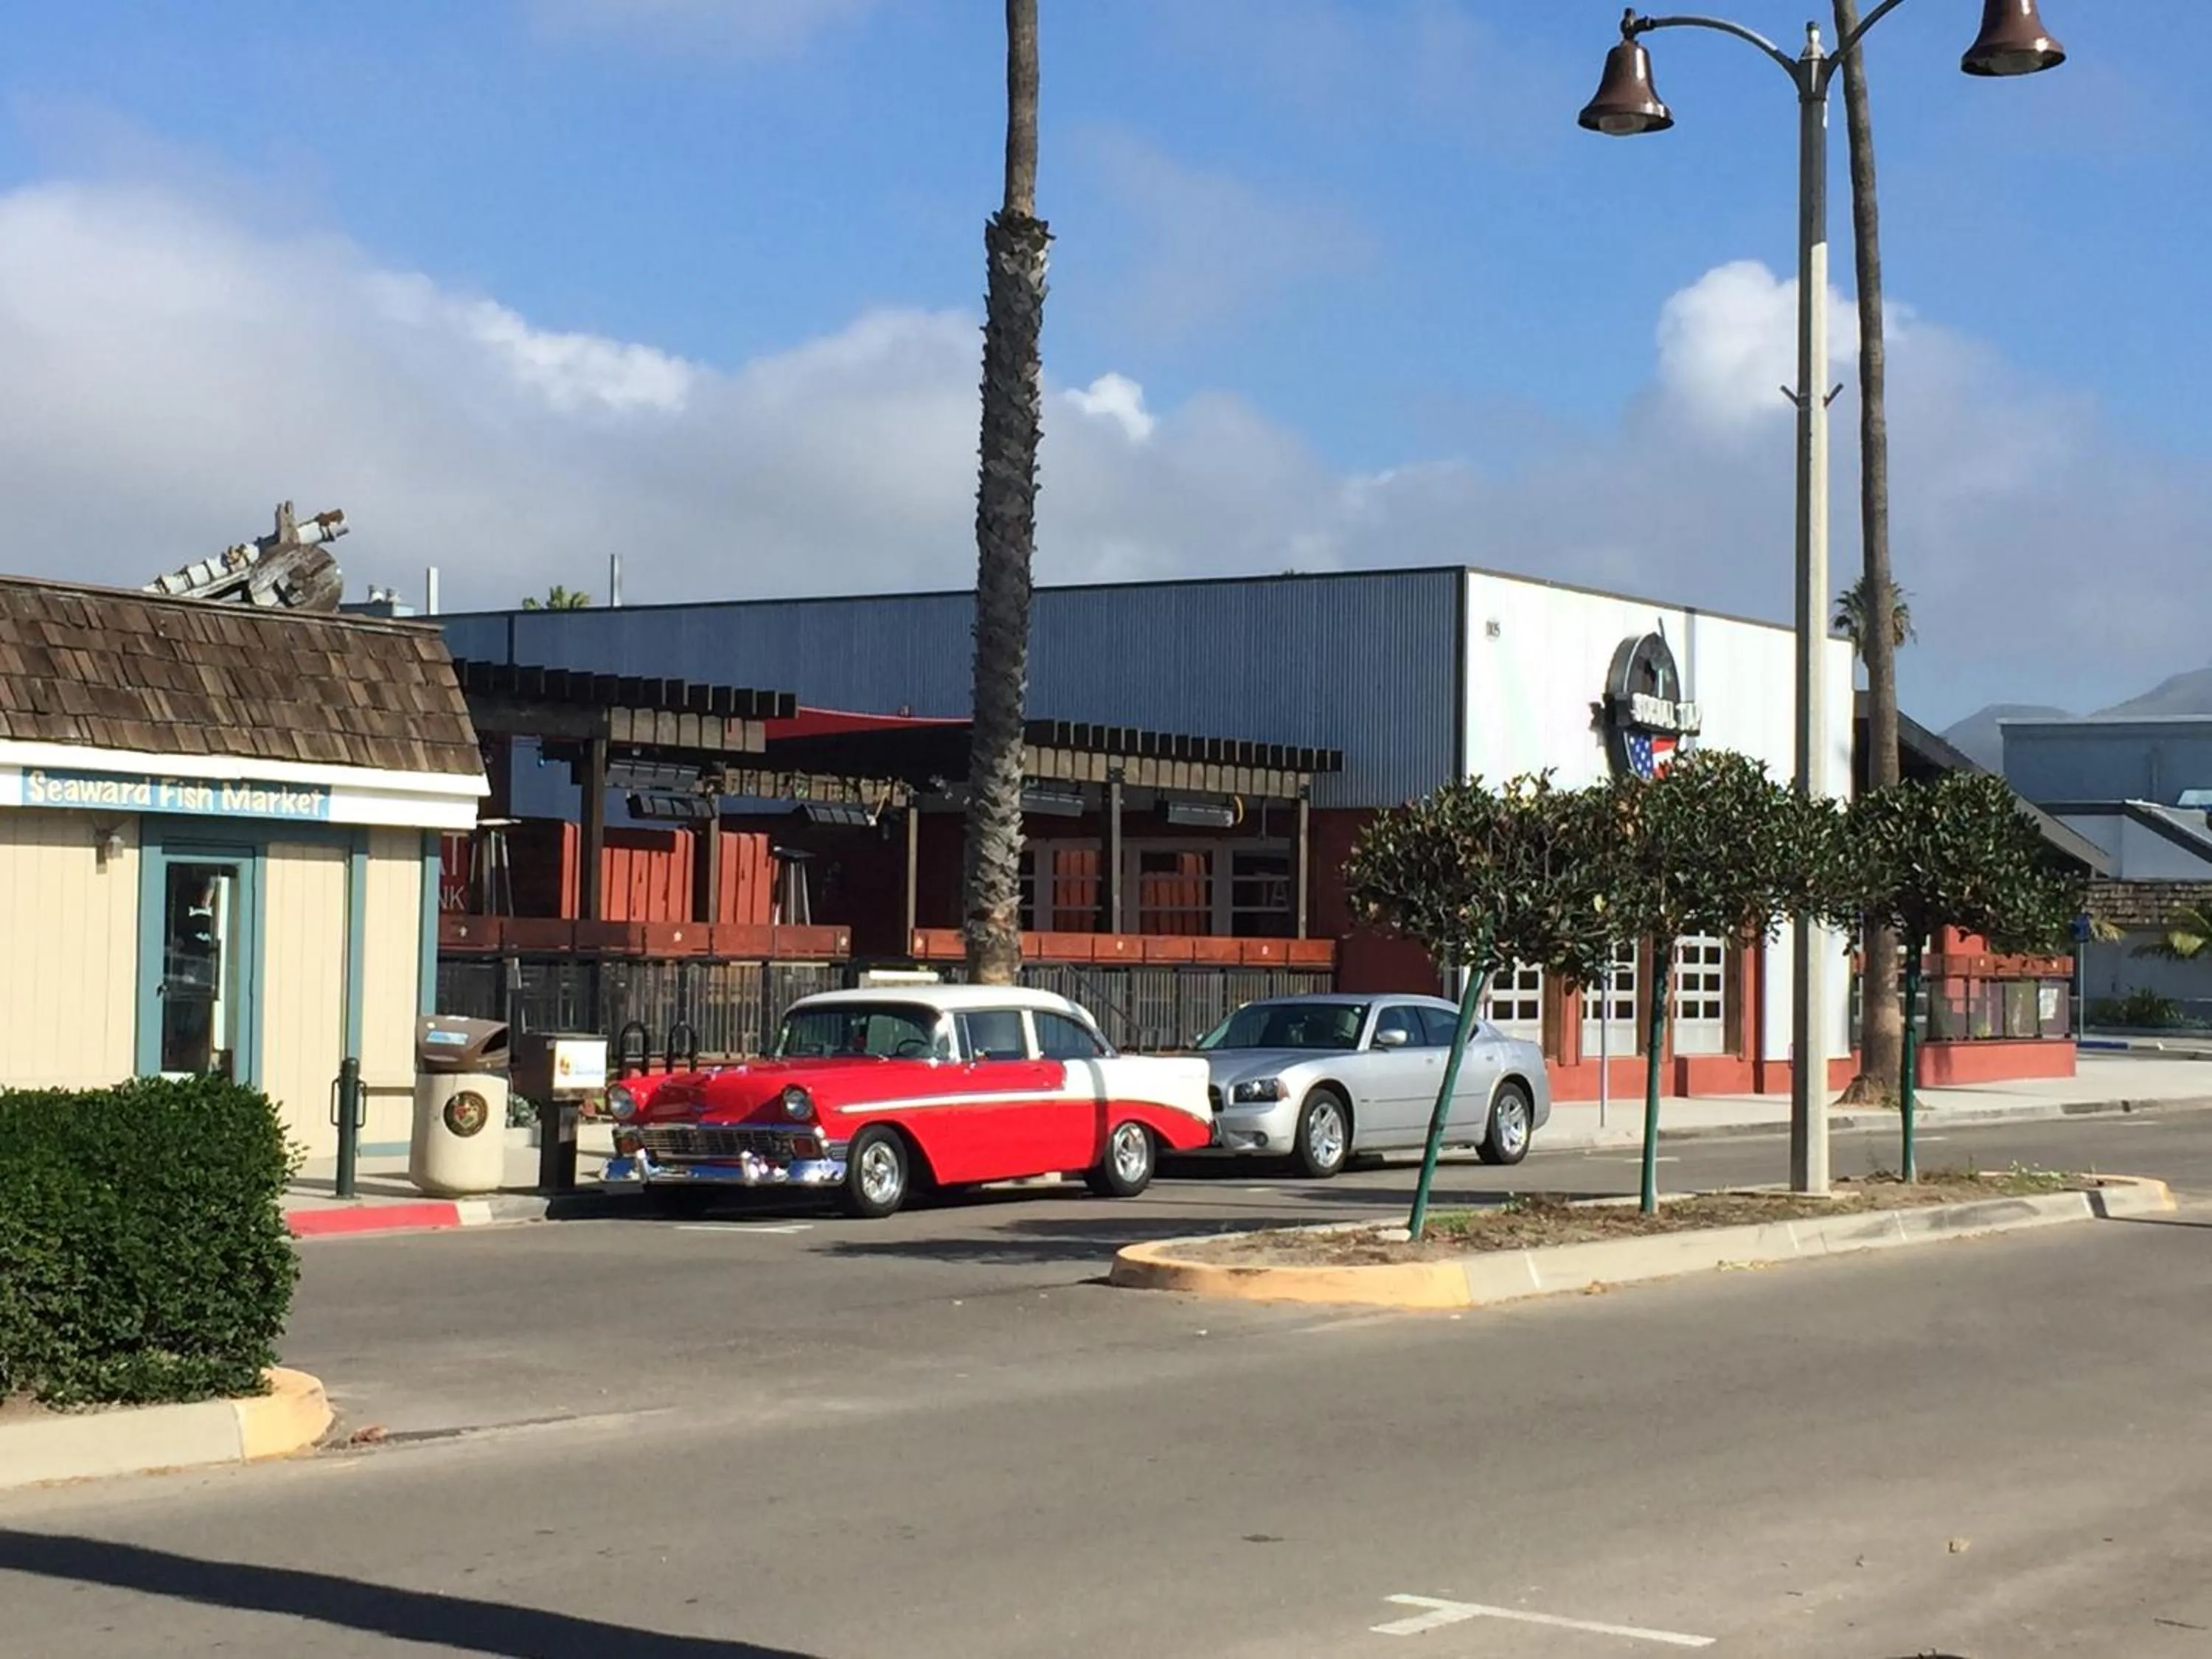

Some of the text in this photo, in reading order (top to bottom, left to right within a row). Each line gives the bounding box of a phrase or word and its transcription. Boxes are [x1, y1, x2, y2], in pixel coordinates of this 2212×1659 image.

[28, 770, 323, 816] Seaward Fish Market
